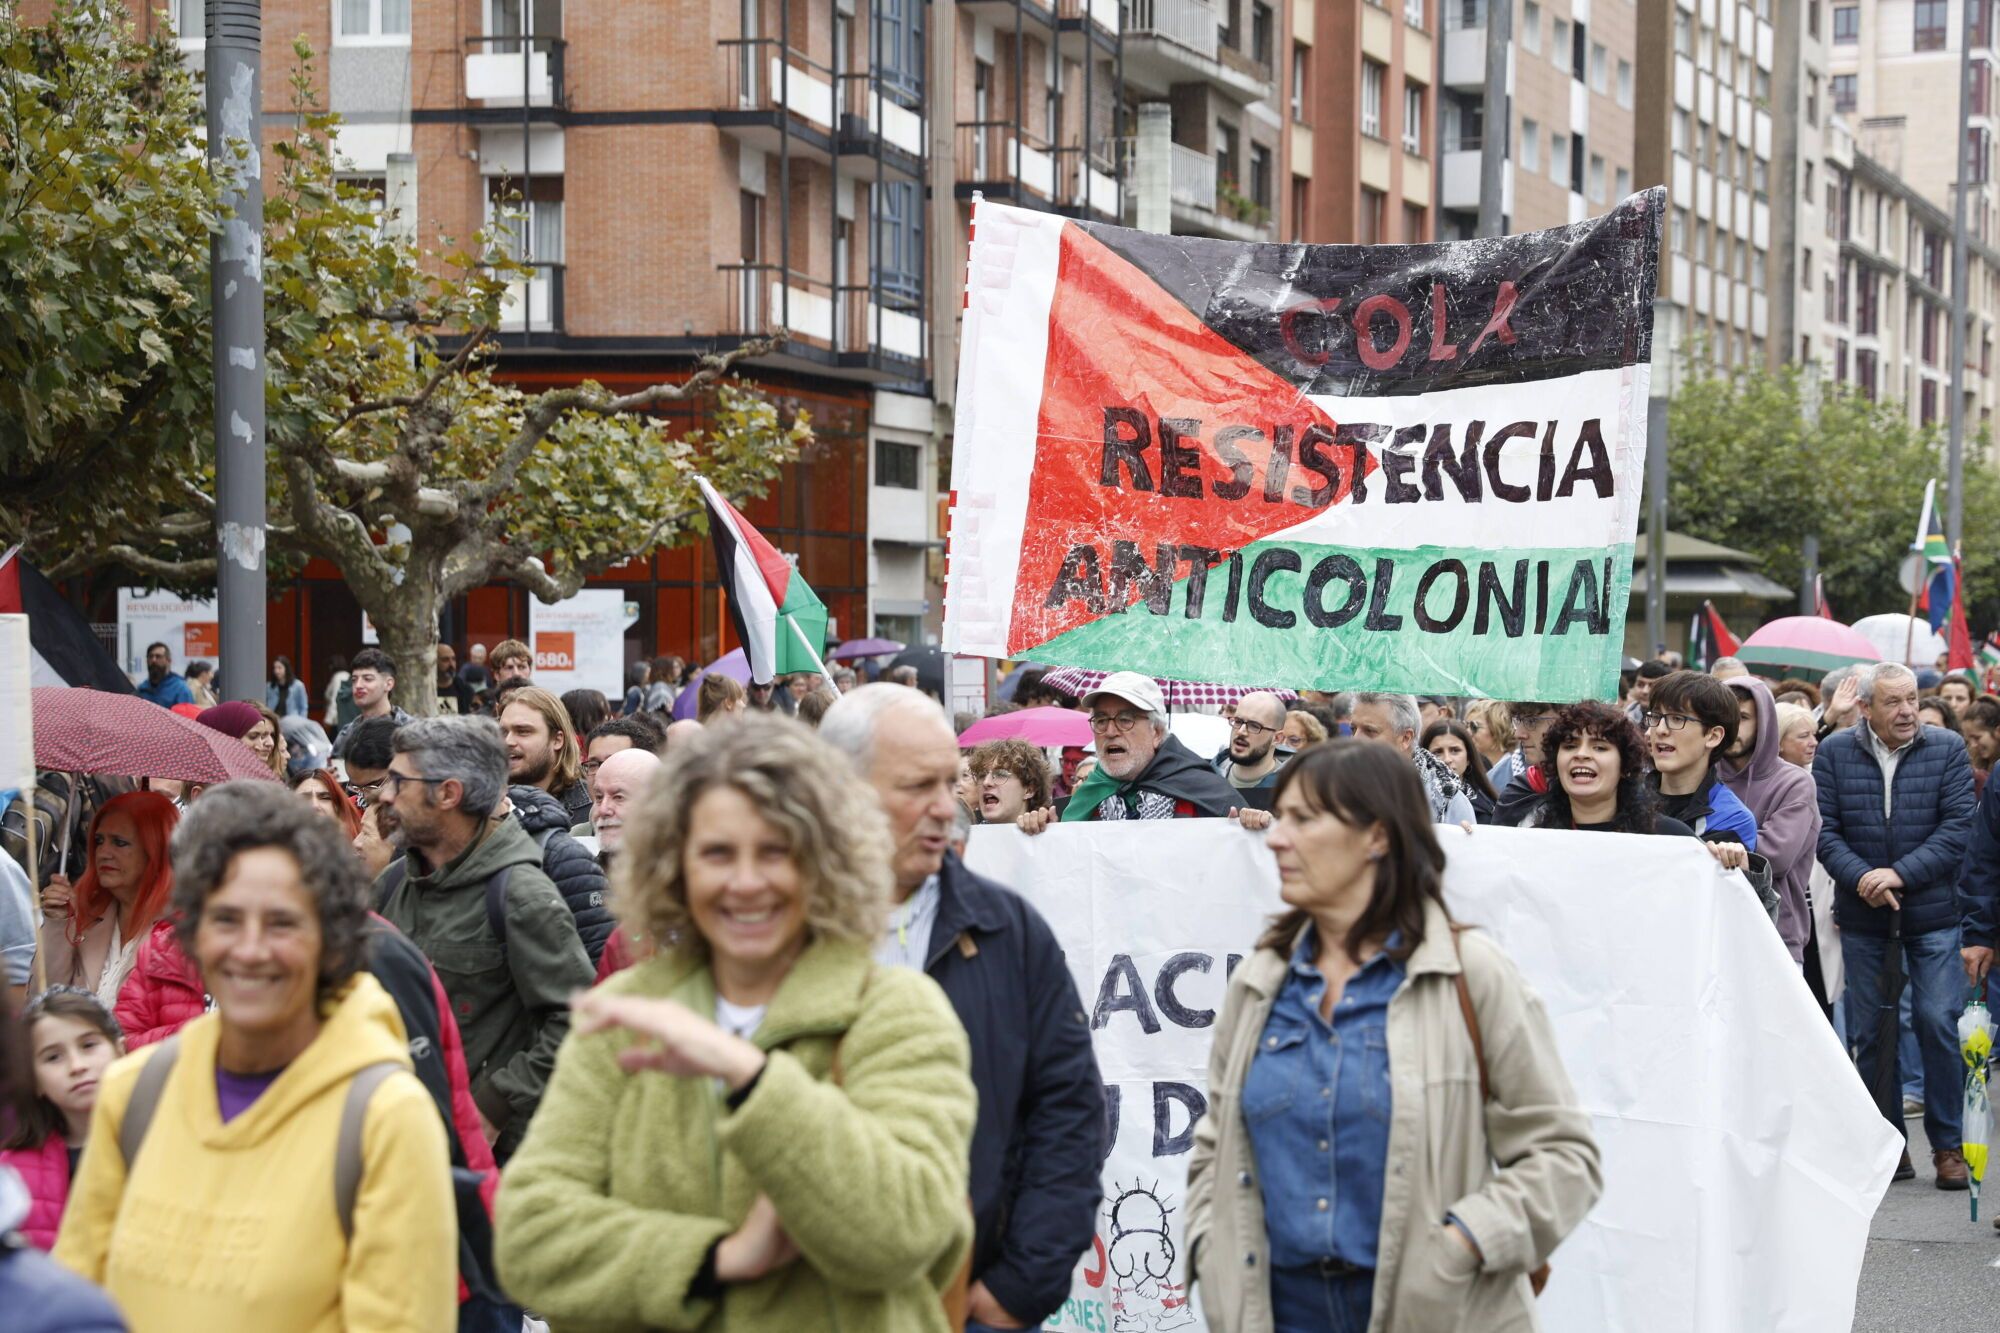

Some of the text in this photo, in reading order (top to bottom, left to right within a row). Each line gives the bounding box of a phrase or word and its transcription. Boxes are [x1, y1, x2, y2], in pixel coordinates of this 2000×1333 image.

[1282, 282, 1518, 370] COLA
[1099, 405, 1615, 508] RESISTENCIA
[1090, 951, 1243, 1035] AC
